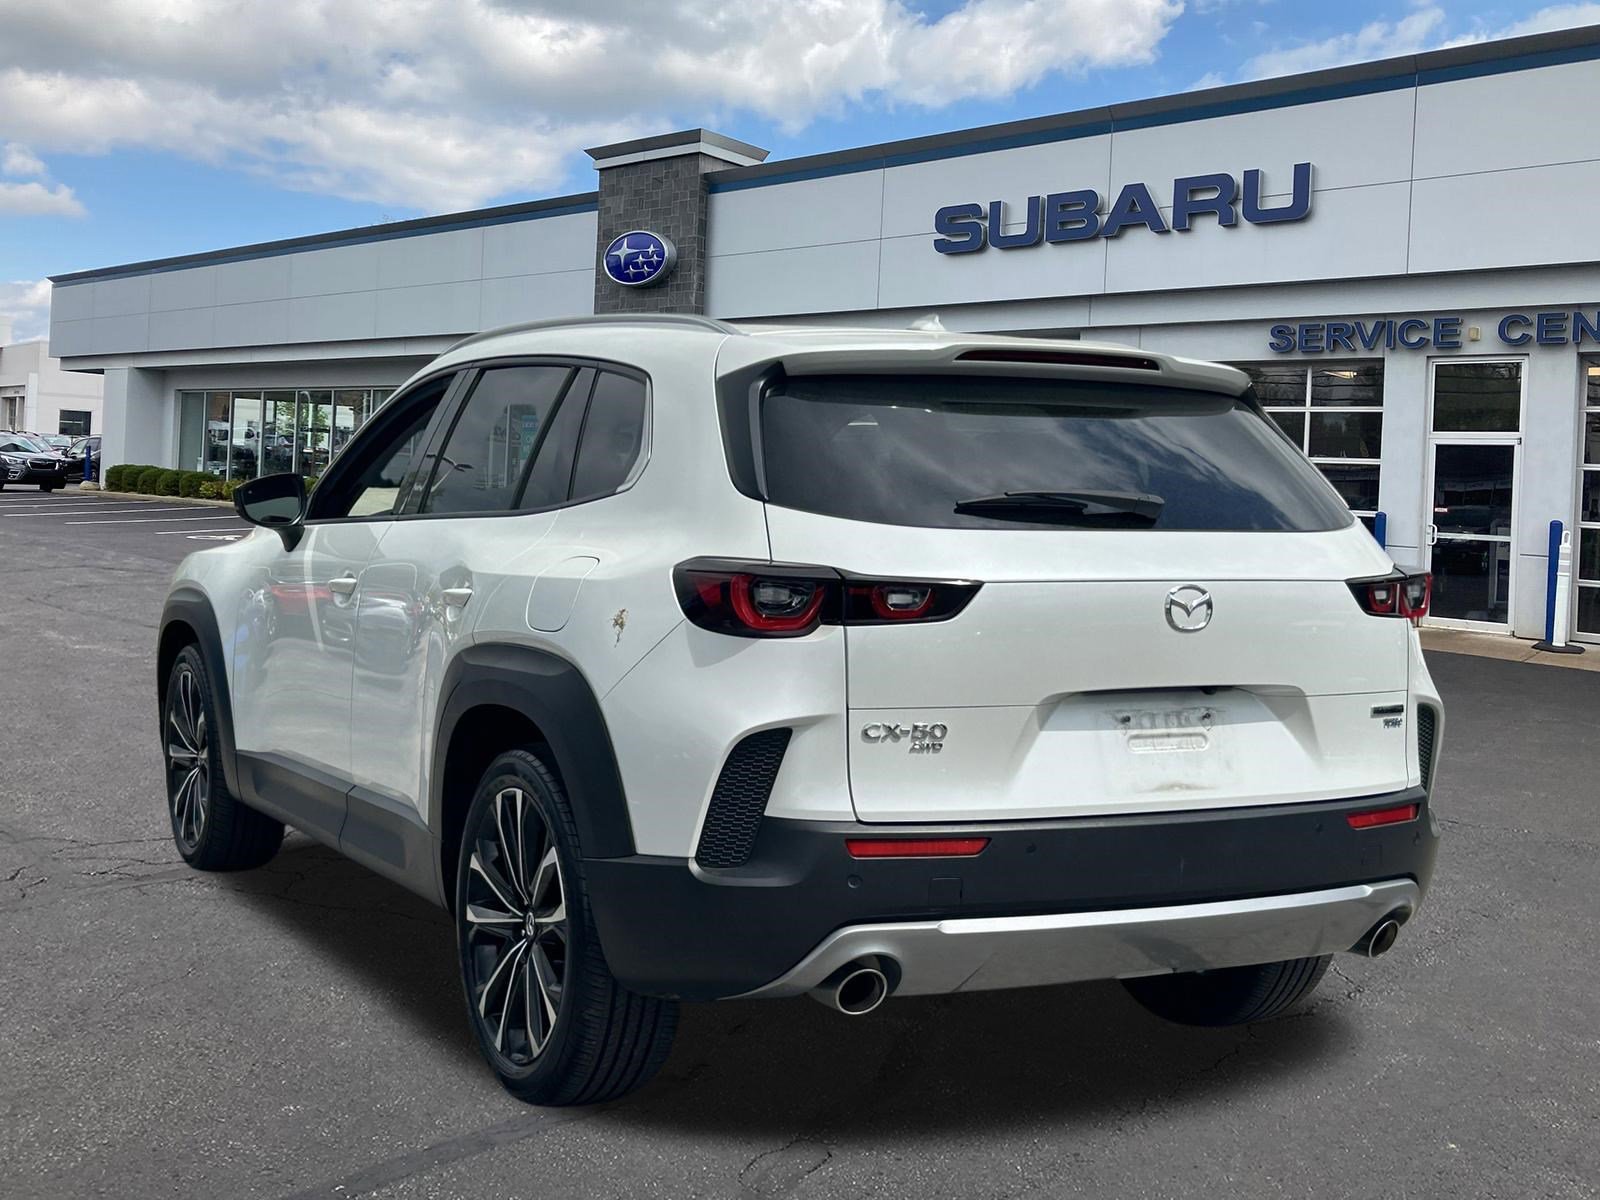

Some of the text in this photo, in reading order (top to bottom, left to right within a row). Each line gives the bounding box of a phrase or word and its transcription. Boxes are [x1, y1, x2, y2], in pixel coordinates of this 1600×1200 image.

[933, 162, 1313, 254] SUBARU
[1269, 318, 1463, 352] SERVICE
[861, 722, 948, 744] CX-50
[909, 741, 943, 755] AWD
